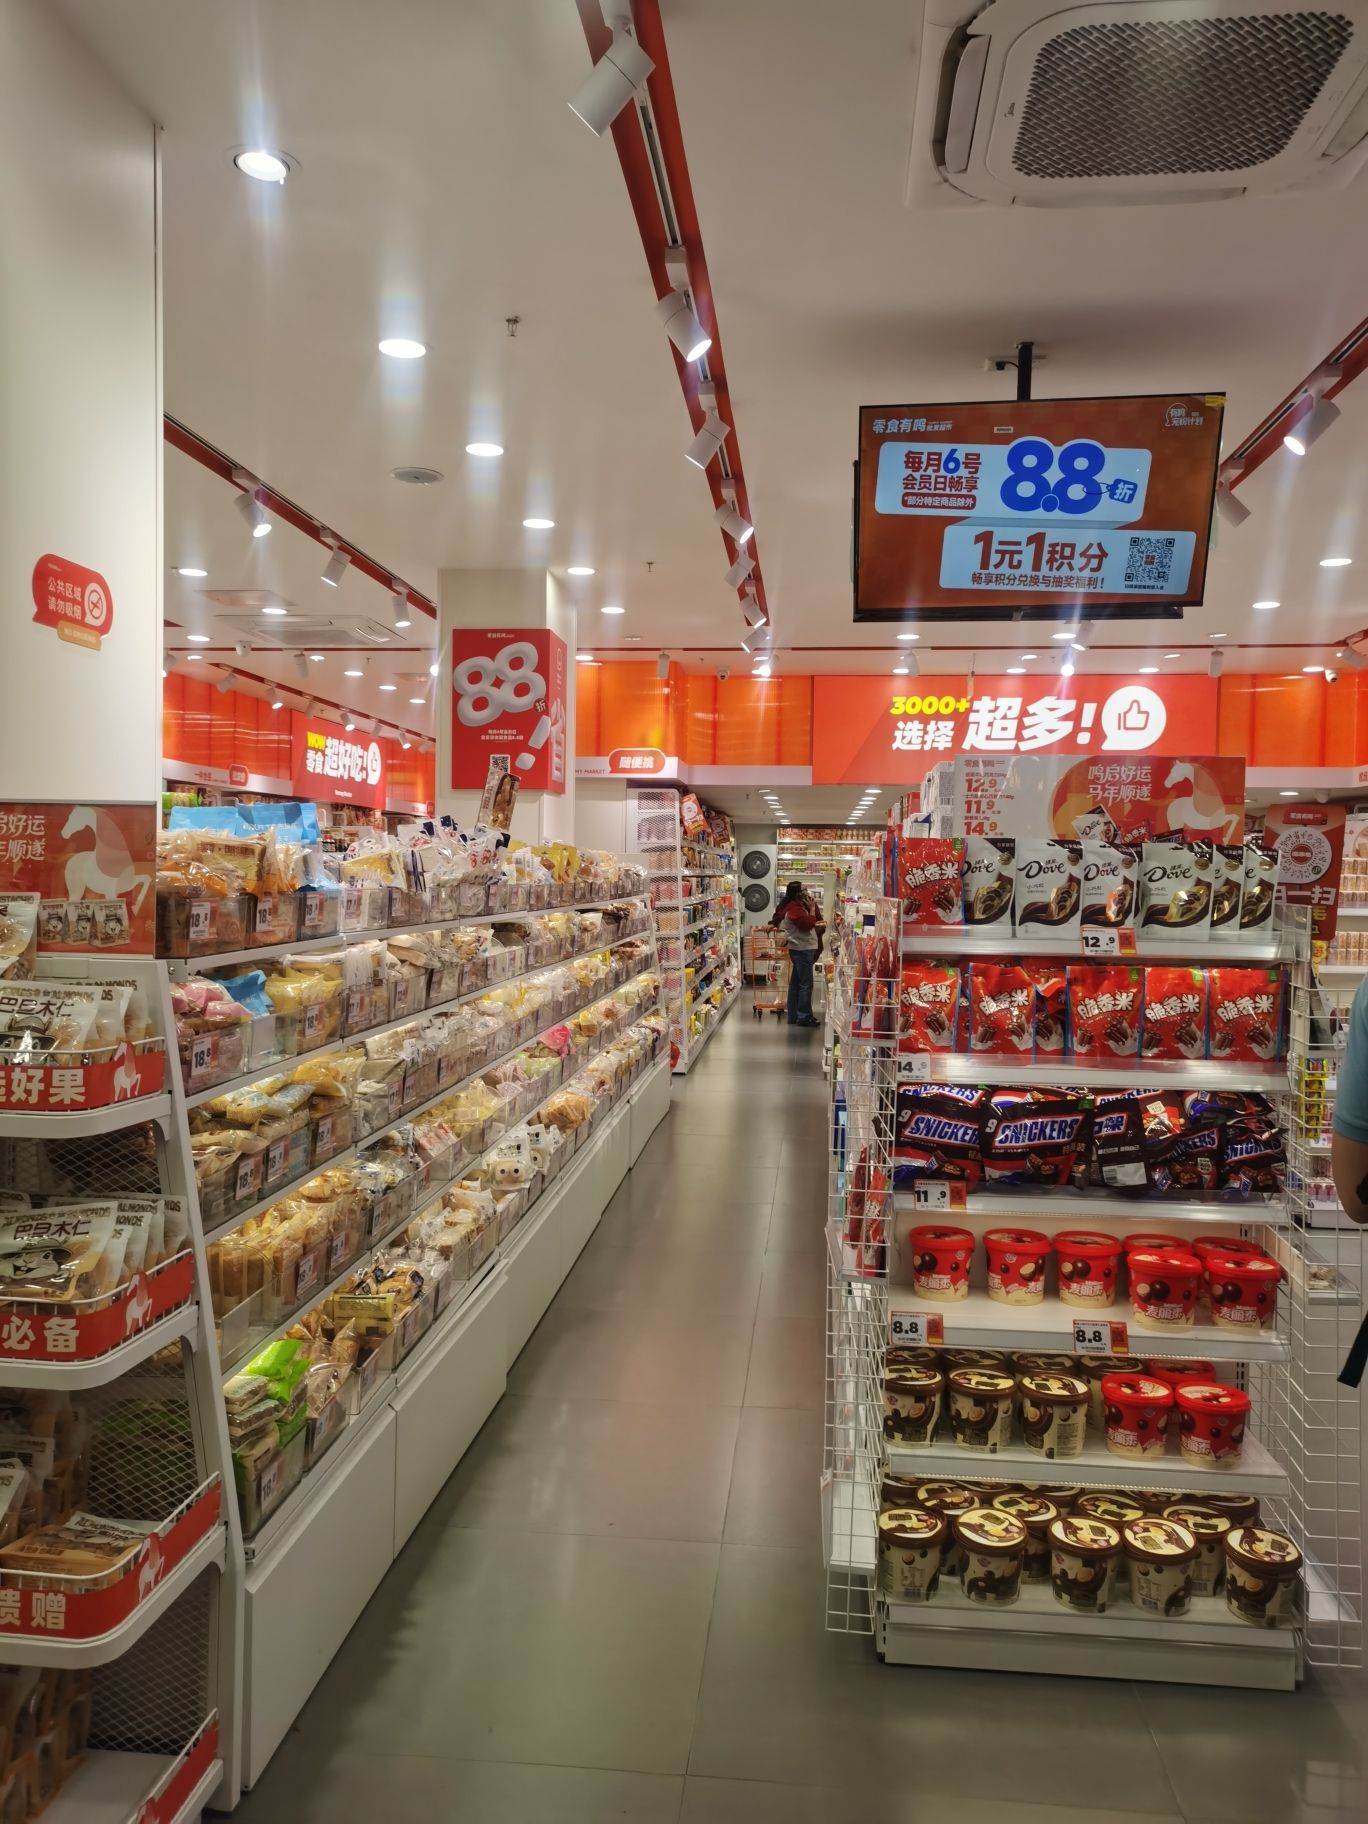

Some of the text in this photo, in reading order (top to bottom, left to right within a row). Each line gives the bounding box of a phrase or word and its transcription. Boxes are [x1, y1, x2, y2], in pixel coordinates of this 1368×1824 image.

[872, 418, 927, 434] 零食有鸣
[903, 448, 982, 475] 每月6号
[902, 474, 980, 493] 会员日畅享
[1113, 480, 1134, 502] 折
[973, 530, 1109, 573] 1元1积分
[48, 576, 82, 602] 公共区域
[889, 695, 971, 715] 3000+
[892, 720, 955, 751] 选择
[1088, 764, 1152, 784] 鸣启好运
[1087, 783, 1152, 807] 马年顺遂
[964, 799, 995, 814] 11.9
[964, 821, 998, 836] 14.9
[904, 860, 960, 889] 脆香米
[1017, 860, 1067, 879] Dove
[1083, 862, 1121, 882] Dove
[1143, 866, 1194, 883] Dove
[1082, 936, 1116, 948] 12.9
[978, 988, 1030, 1016] 脆香米
[1076, 991, 1134, 1020] 脆香米
[1145, 993, 1200, 1022] 脆香米
[1216, 993, 1274, 1023] 脆香米
[910, 1116, 980, 1146] SNICKER
[1000, 1118, 1079, 1145] SNICKERS
[915, 1190, 947, 1203] 11.9
[1145, 1305, 1183, 1321] 麦丽素
[1219, 1306, 1256, 1323] 麦丽素
[1, 1315, 80, 1353] 必备
[893, 1321, 919, 1334] 8.8
[1075, 1330, 1103, 1344] 8.8
